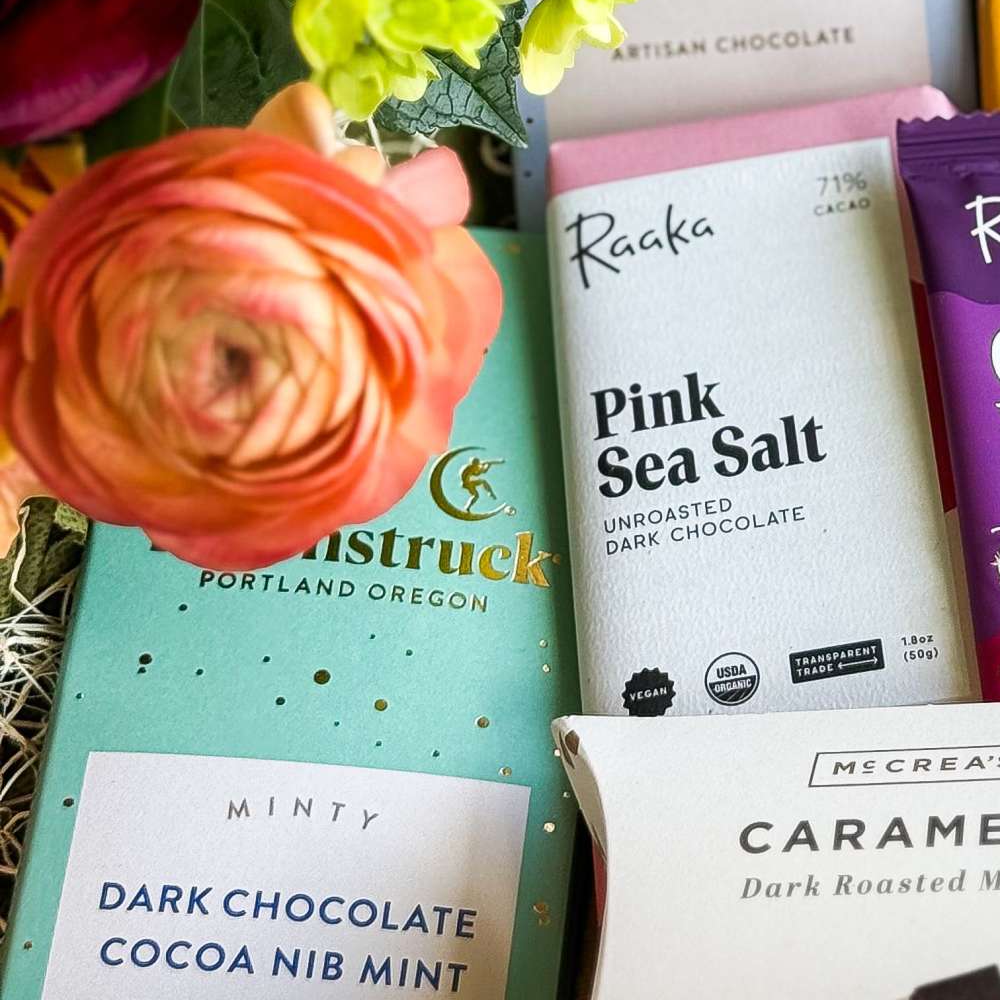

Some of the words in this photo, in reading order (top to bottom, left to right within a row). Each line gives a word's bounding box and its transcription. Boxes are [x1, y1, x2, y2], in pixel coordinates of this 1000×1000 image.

[611, 40, 706, 62] ARTISAN
[715, 27, 855, 56] CHOCOLATE
[816, 171, 868, 197] 71%
[813, 198, 871, 217] CACAO
[565, 203, 715, 290] Raaka
[590, 371, 725, 440] Pink
[597, 444, 700, 498] Sea
[711, 414, 828, 477] Salt
[603, 497, 732, 534] UNROASTED
[606, 531, 661, 556] DARK
[670, 506, 806, 543] CHOCOLATE
[199, 569, 355, 598] PORTLAND
[368, 583, 488, 613] OREGON
[795, 645, 877, 667] TRANSPARENT
[901, 634, 935, 647] 1.8oz
[903, 647, 940, 664] (50g)
[714, 678, 752, 694] ORGANIC
[716, 663, 747, 679] USDA
[796, 664, 834, 677] TRADE
[629, 686, 668, 701] VEGAN
[227, 796, 379, 831] MINTY
[740, 874, 821, 900] Dark
[832, 868, 966, 897] Roasted
[98, 882, 213, 917] DARK
[222, 888, 477, 939] CHOCOLATE
[99, 937, 254, 976] COCOA
[271, 947, 345, 982] NIB
[360, 953, 468, 994] MINT
